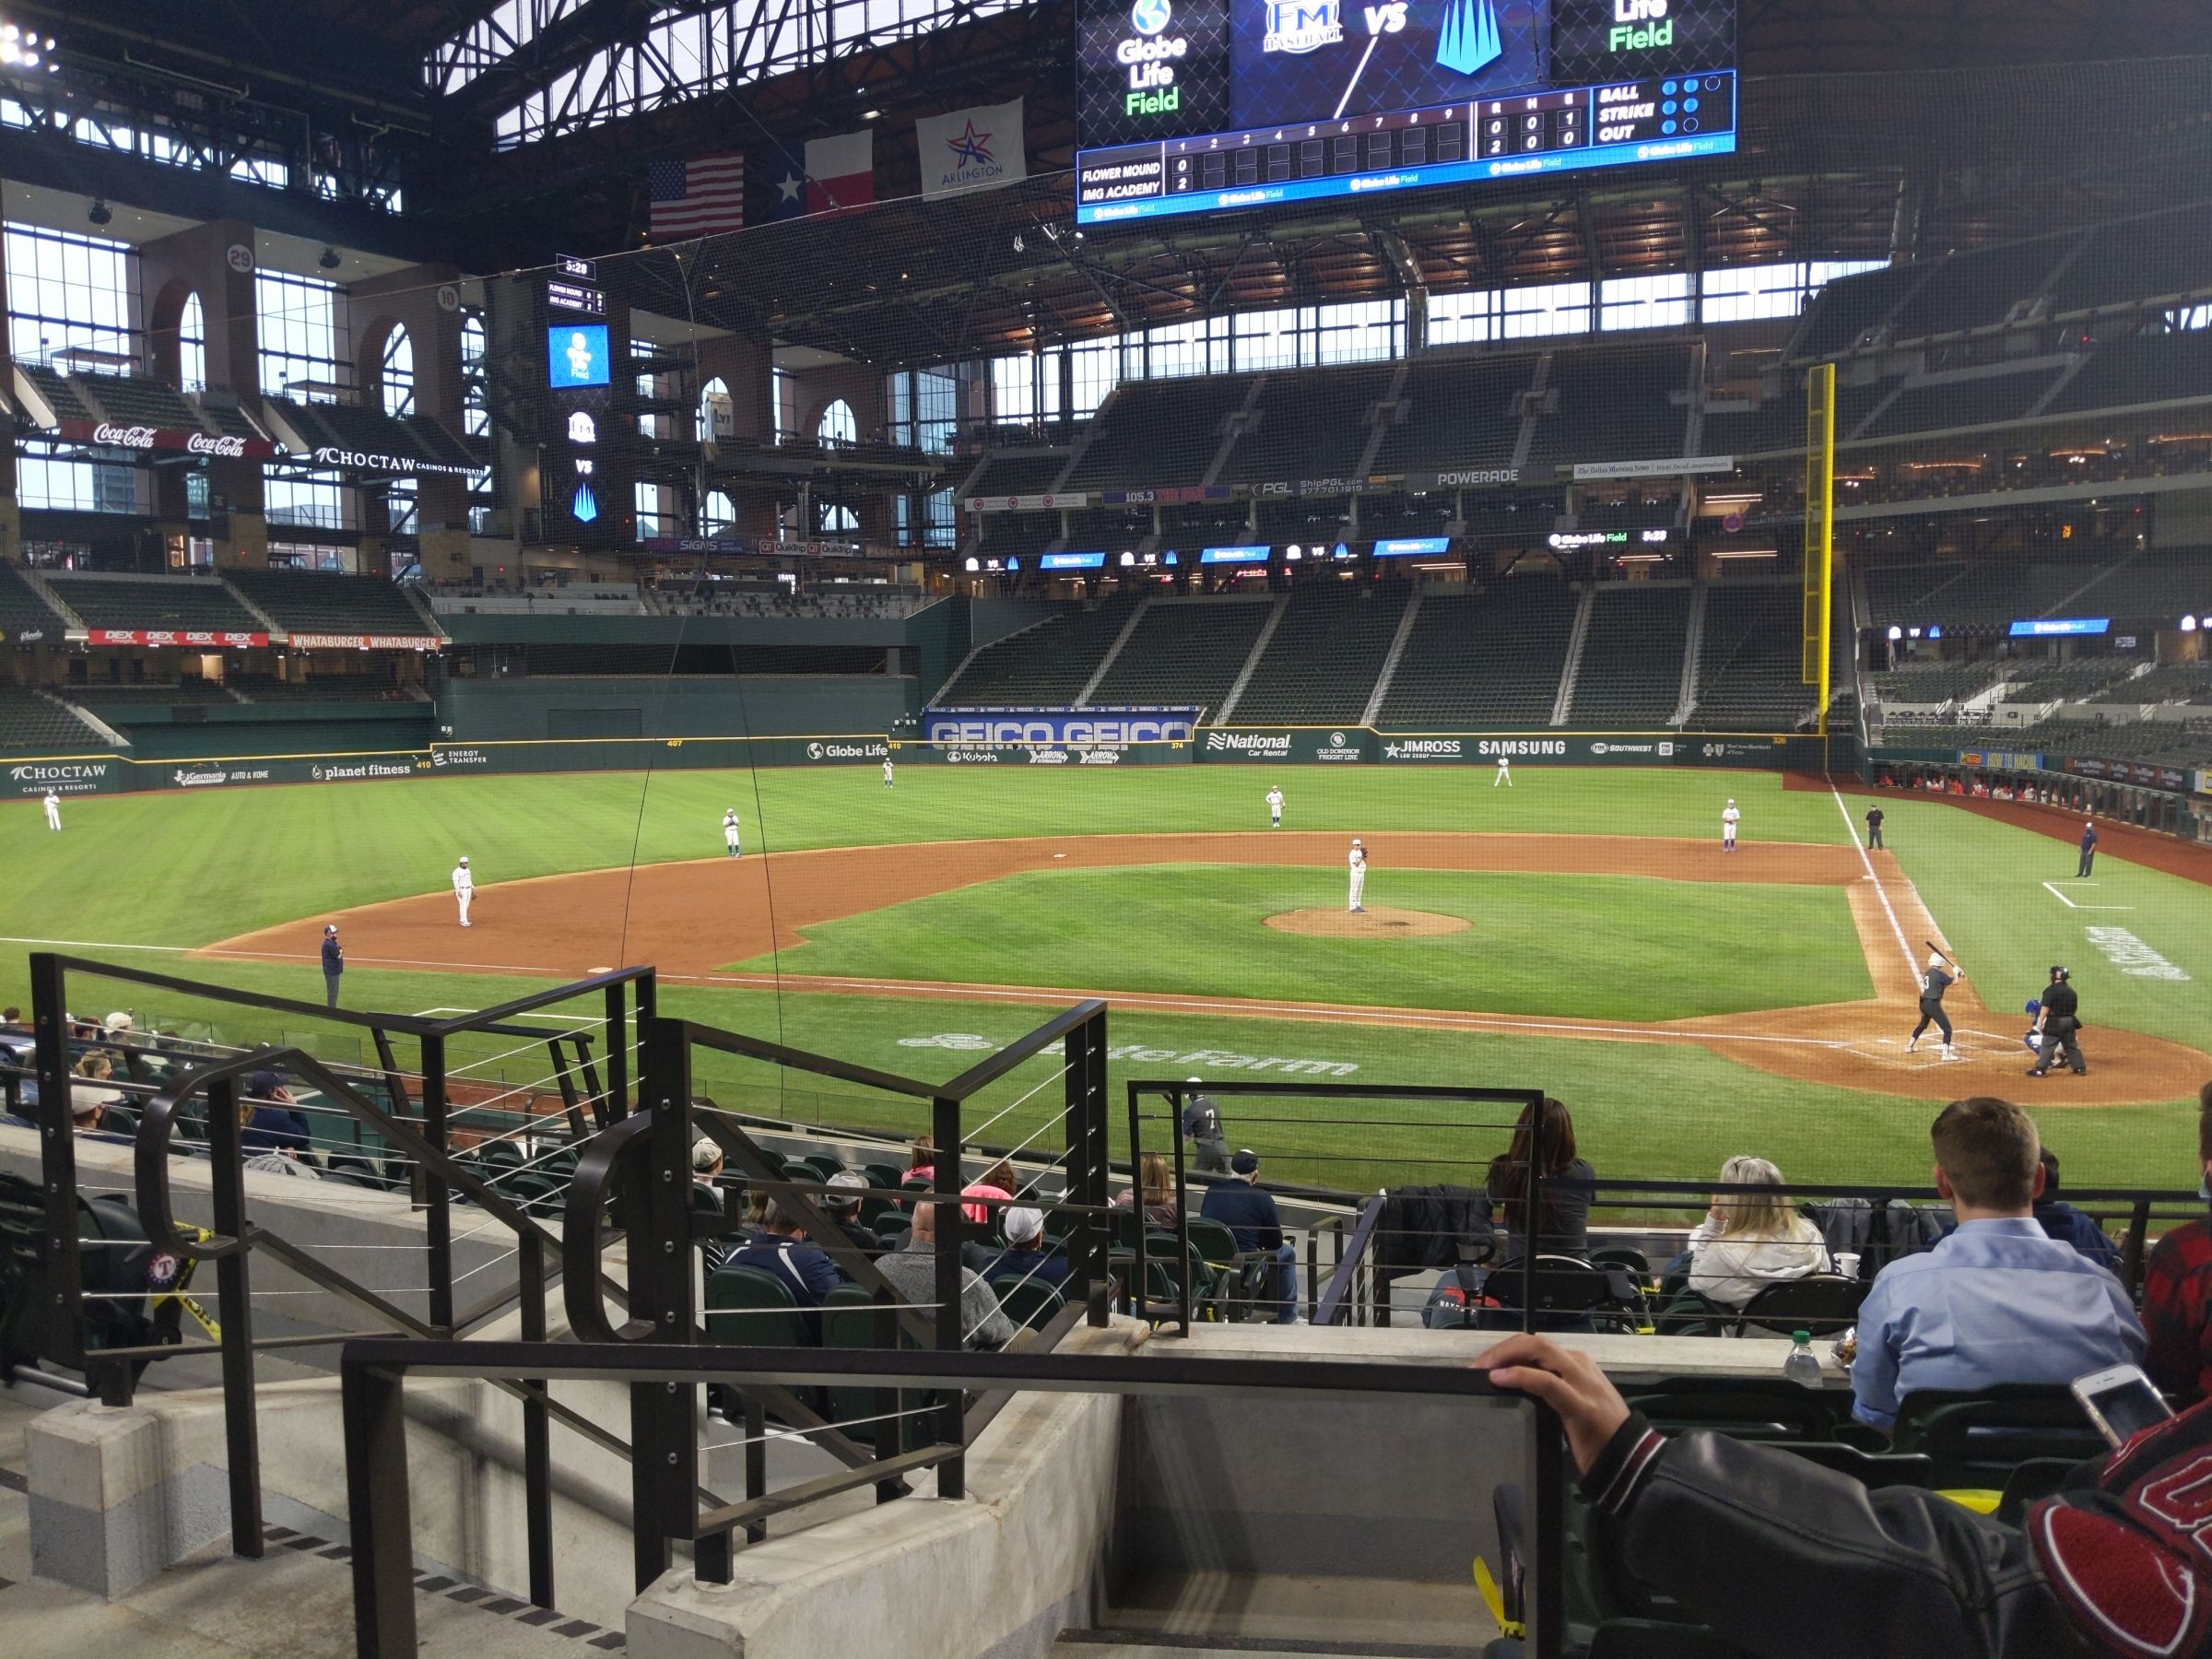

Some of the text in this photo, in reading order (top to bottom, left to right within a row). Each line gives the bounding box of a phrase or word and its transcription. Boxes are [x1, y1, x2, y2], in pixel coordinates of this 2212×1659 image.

[1273, 1, 1331, 34] FM
[1364, 2, 1408, 35] VS
[1615, 0, 1666, 22] Life
[1265, 27, 1343, 51] BASEBALL
[1610, 19, 1673, 53] Field
[1116, 35, 1187, 65] Globe
[1130, 61, 1174, 88] Life
[1126, 87, 1179, 116] Field
[1600, 86, 1639, 103] BALL
[1599, 102, 1655, 123] STRIKE
[1180, 142, 1185, 151] 1
[1210, 139, 1218, 148] 2
[1242, 135, 1251, 144] 3
[1275, 130, 1282, 140] 4
[1308, 126, 1316, 136] 5
[1341, 122, 1349, 132] 6
[1375, 118, 1383, 127] 7
[1410, 113, 1418, 124] 8
[1445, 109, 1453, 119] 9
[1491, 102, 1501, 113] R
[1527, 98, 1537, 110] H
[1599, 124, 1635, 141] OUT
[1082, 112, 1573, 182] FLOWER MOUND 0 0 0 1
[1082, 132, 1573, 201] IMG ACADEMY 2 2 0 0
[1543, 158, 1562, 168] Field
[942, 164, 1003, 185] ARLINGTON
[1400, 173, 1418, 183] Field
[1265, 189, 1283, 199] Field
[230, 251, 251, 267] 29
[566, 260, 588, 275] 5:28
[441, 290, 454, 306] 10
[93, 422, 158, 448] Coca-Cola
[187, 432, 247, 457] Coca-Cola
[325, 448, 416, 472] CHOCTAW
[416, 463, 447, 473] CASINOS
[453, 466, 484, 477] RESORTS
[575, 459, 593, 475] VS
[1437, 468, 1519, 486] POWERADE
[1125, 490, 1155, 503] 105.3
[1262, 482, 1294, 495] PGL
[679, 540, 717, 551] SIGNS
[1588, 534, 1606, 544] Life
[1606, 532, 1628, 543] Field
[775, 544, 806, 553] QuikTrip
[821, 545, 853, 554] QuikTrip
[105, 630, 135, 640] DEX
[146, 631, 175, 641] DEX
[186, 632, 214, 641] DEX
[224, 632, 252, 641] DEX
[293, 635, 365, 648] WHATABURGER
[370, 636, 437, 649] WHATABURGER
[931, 722, 1194, 750] GEICO GEICO
[826, 742, 889, 758] Globe Life
[1248, 748, 1288, 758] Car Rental
[1478, 740, 1566, 755] SAMSUNG
[1609, 745, 1653, 753] SOUTHWEST
[449, 756, 488, 764] TRANSFER
[962, 752, 999, 763] Kubota
[20, 764, 107, 780] CHOCTAW
[189, 771, 227, 781] Germania
[230, 771, 246, 781] AUTO
[253, 771, 269, 779] HOME
[325, 764, 411, 781] planet fitness
[23, 784, 56, 793] CASINOS
[1205, 1109, 1216, 1130] 7
[159, 1259, 172, 1277] T
